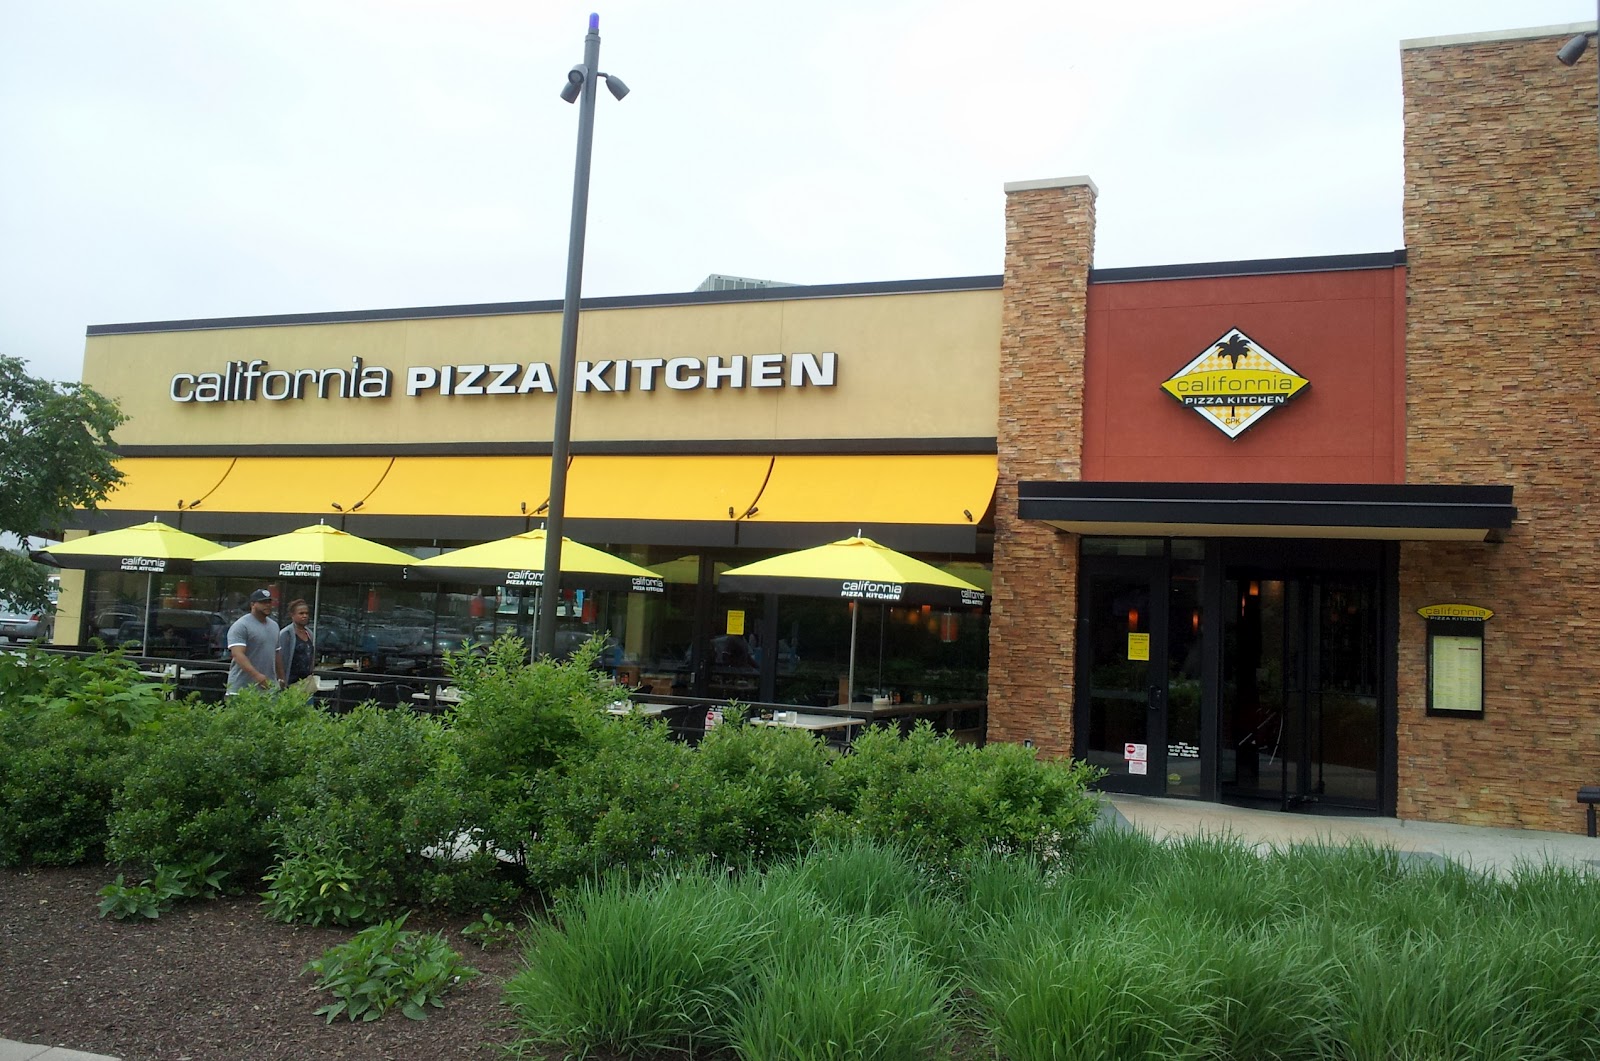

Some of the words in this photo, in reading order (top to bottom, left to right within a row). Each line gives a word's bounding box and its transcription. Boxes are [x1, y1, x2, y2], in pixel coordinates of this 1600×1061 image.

[169, 355, 391, 402] california
[406, 362, 557, 396] PIZZA
[575, 352, 838, 393] KITCHEN
[1177, 375, 1292, 392] california
[1185, 397, 1224, 405] PIZZA
[1227, 395, 1284, 404] KITCHEN
[1225, 417, 1241, 425] CPK
[121, 557, 165, 567] california
[280, 562, 321, 571] california
[843, 581, 902, 593] california
[1426, 608, 1485, 616] california
